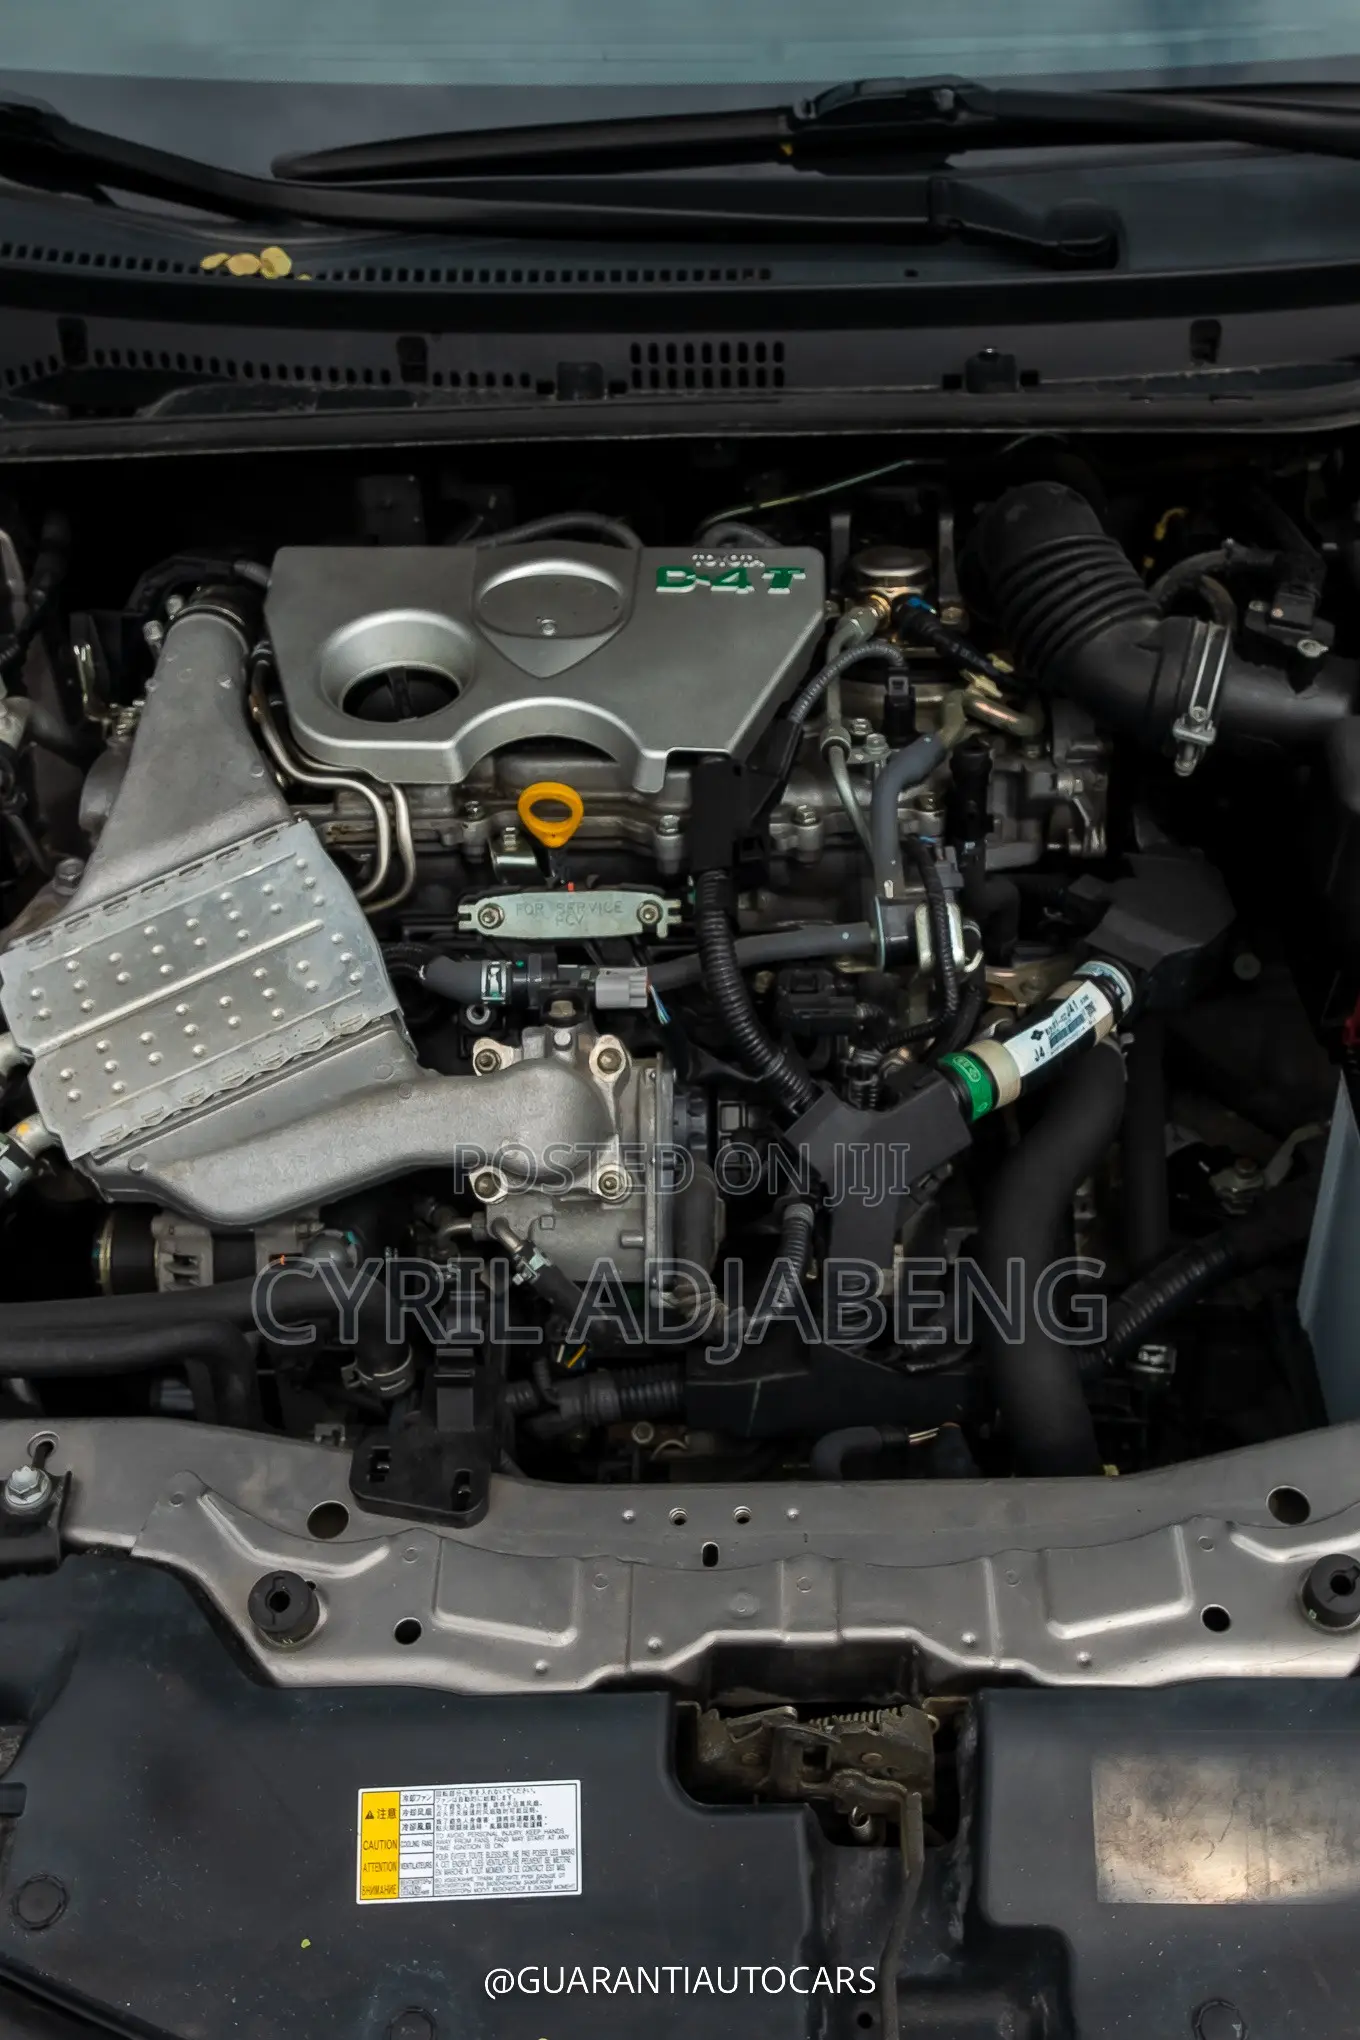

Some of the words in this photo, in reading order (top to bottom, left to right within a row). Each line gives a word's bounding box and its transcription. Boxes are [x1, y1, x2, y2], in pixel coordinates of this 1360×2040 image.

[656, 566, 806, 594] D-4T
[516, 903, 545, 916] FOR
[556, 901, 624, 914] SERVICE
[377, 1808, 397, 1820] 注意
[362, 1840, 397, 1850] CAUTION
[363, 1861, 397, 1872] ATTENTION
[361, 1884, 397, 1895] ВНИМАНИЕ
